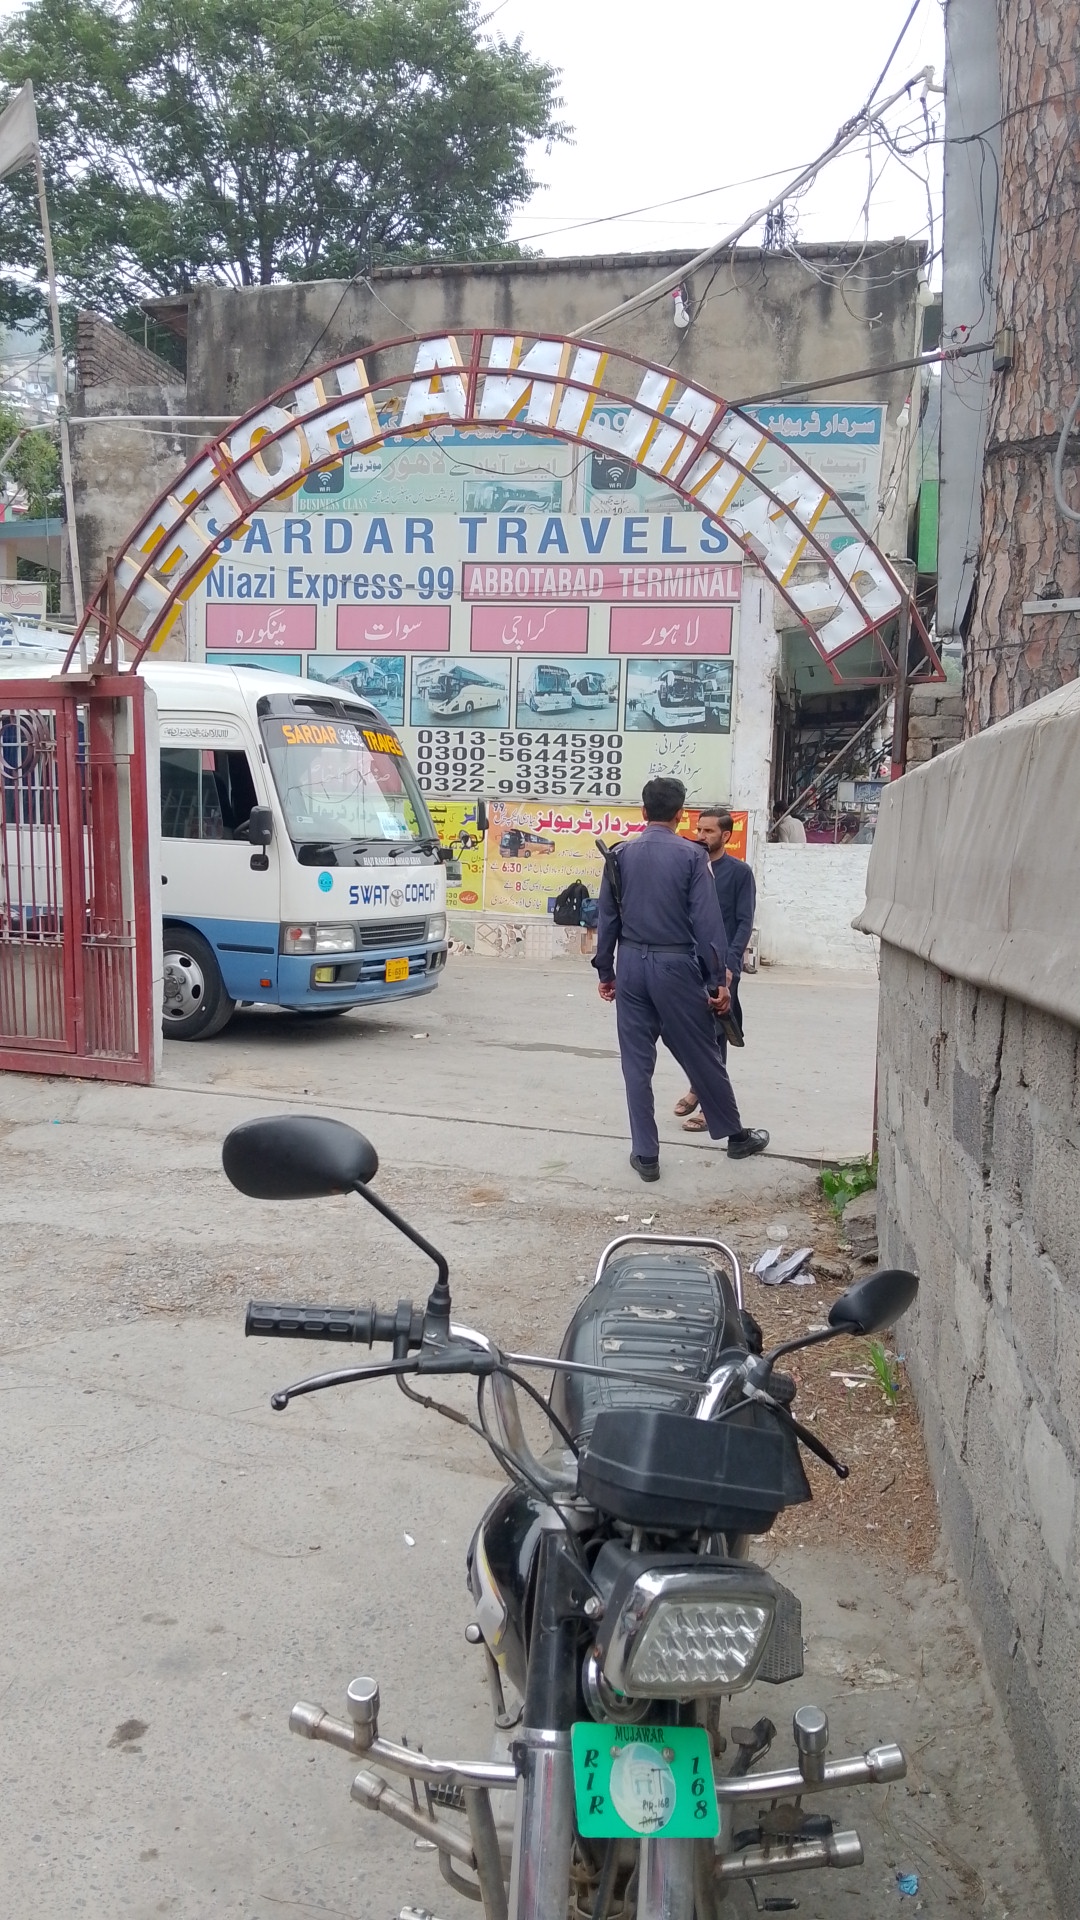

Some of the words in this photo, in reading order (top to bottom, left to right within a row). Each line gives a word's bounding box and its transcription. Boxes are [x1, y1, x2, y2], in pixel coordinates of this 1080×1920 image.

[821, 413, 876, 437] سردار
[299, 498, 340, 512] BUSINESS
[342, 497, 368, 511] CLASS
[206, 516, 435, 556] SARDAR
[458, 515, 730, 555] TRAVELS
[206, 565, 276, 599] Niazi
[287, 564, 455, 607] Express-99
[469, 567, 604, 598] ABBOTABAD
[618, 565, 739, 599] TERMINAL
[235, 607, 288, 646] مینگورہ
[363, 614, 423, 642] سوات
[501, 607, 557, 650] کراچی
[642, 616, 700, 647] لاہور
[282, 725, 340, 744] SARDAR
[417, 729, 624, 749] 0313-5644590
[417, 745, 624, 765] 0300-5644590
[515, 764, 623, 781] 335238
[418, 776, 622, 797] 0322-9935740
[533, 809, 593, 834] ٹریولز
[501, 862, 523, 874] 6:30
[348, 884, 391, 907] SWAT
[404, 882, 437, 904] COACH
[515, 881, 522, 892] 8
[614, 1725, 665, 1743] MUJAWAR
